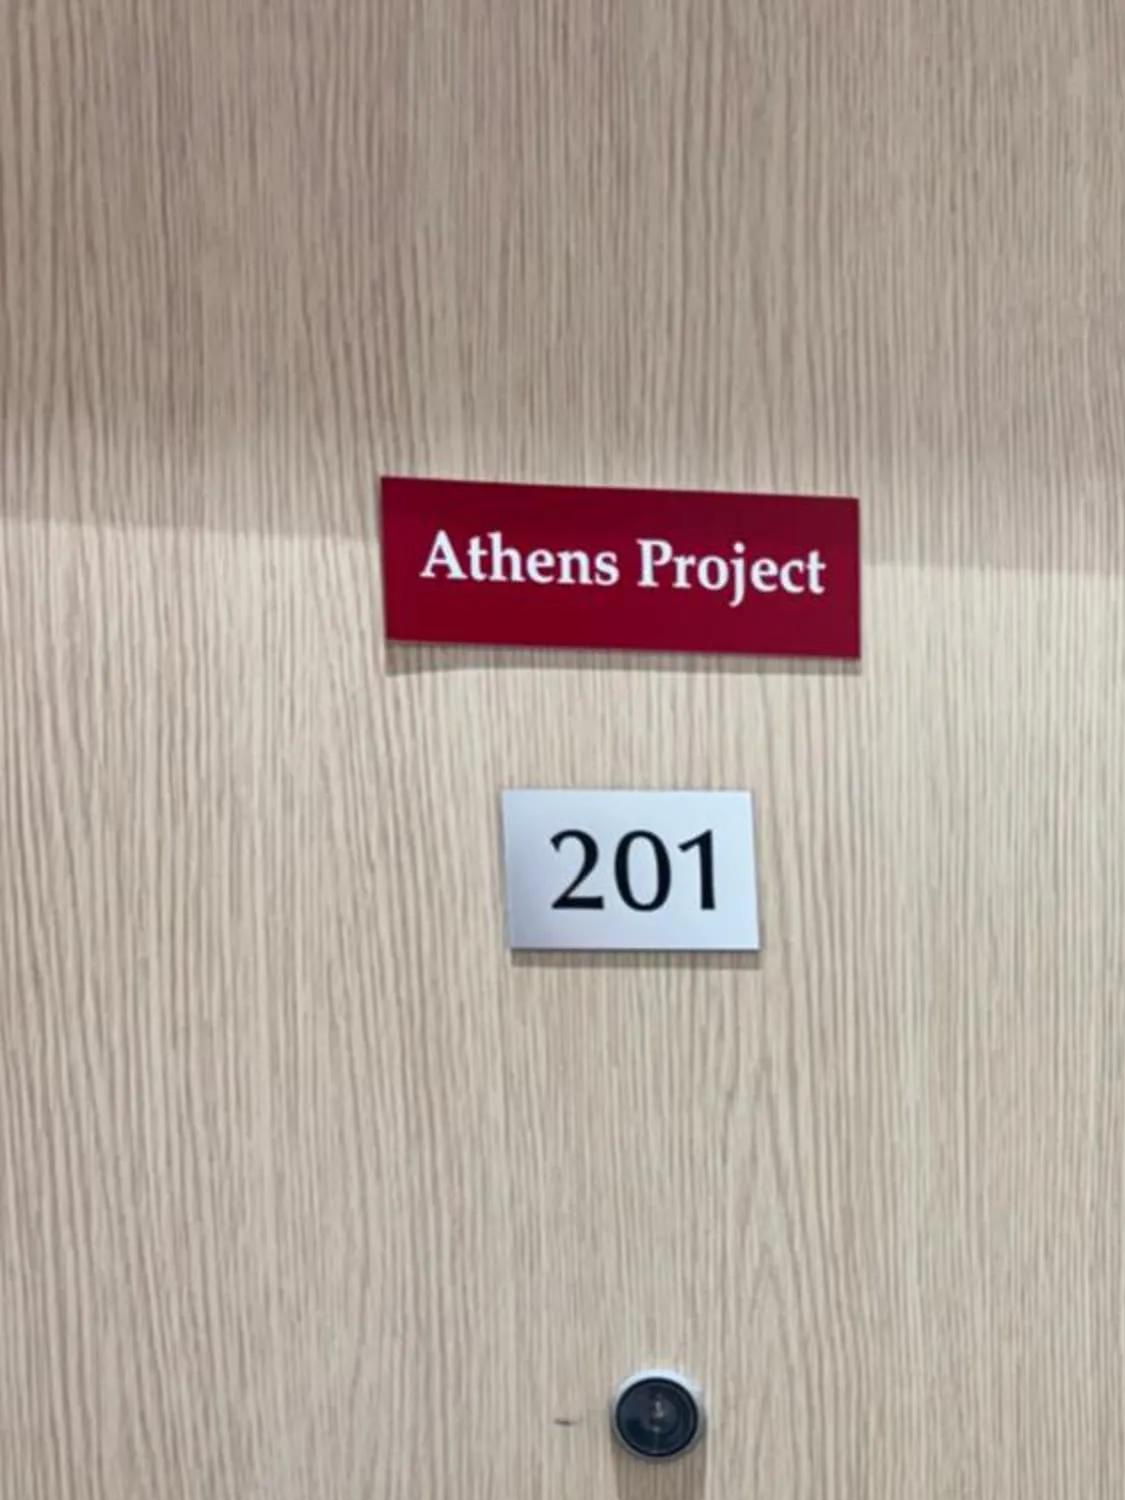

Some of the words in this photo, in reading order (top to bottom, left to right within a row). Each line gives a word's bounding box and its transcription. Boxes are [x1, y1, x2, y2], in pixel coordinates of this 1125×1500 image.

[420, 530, 620, 586] Athens
[637, 539, 826, 607] Project
[550, 829, 715, 912] 201
